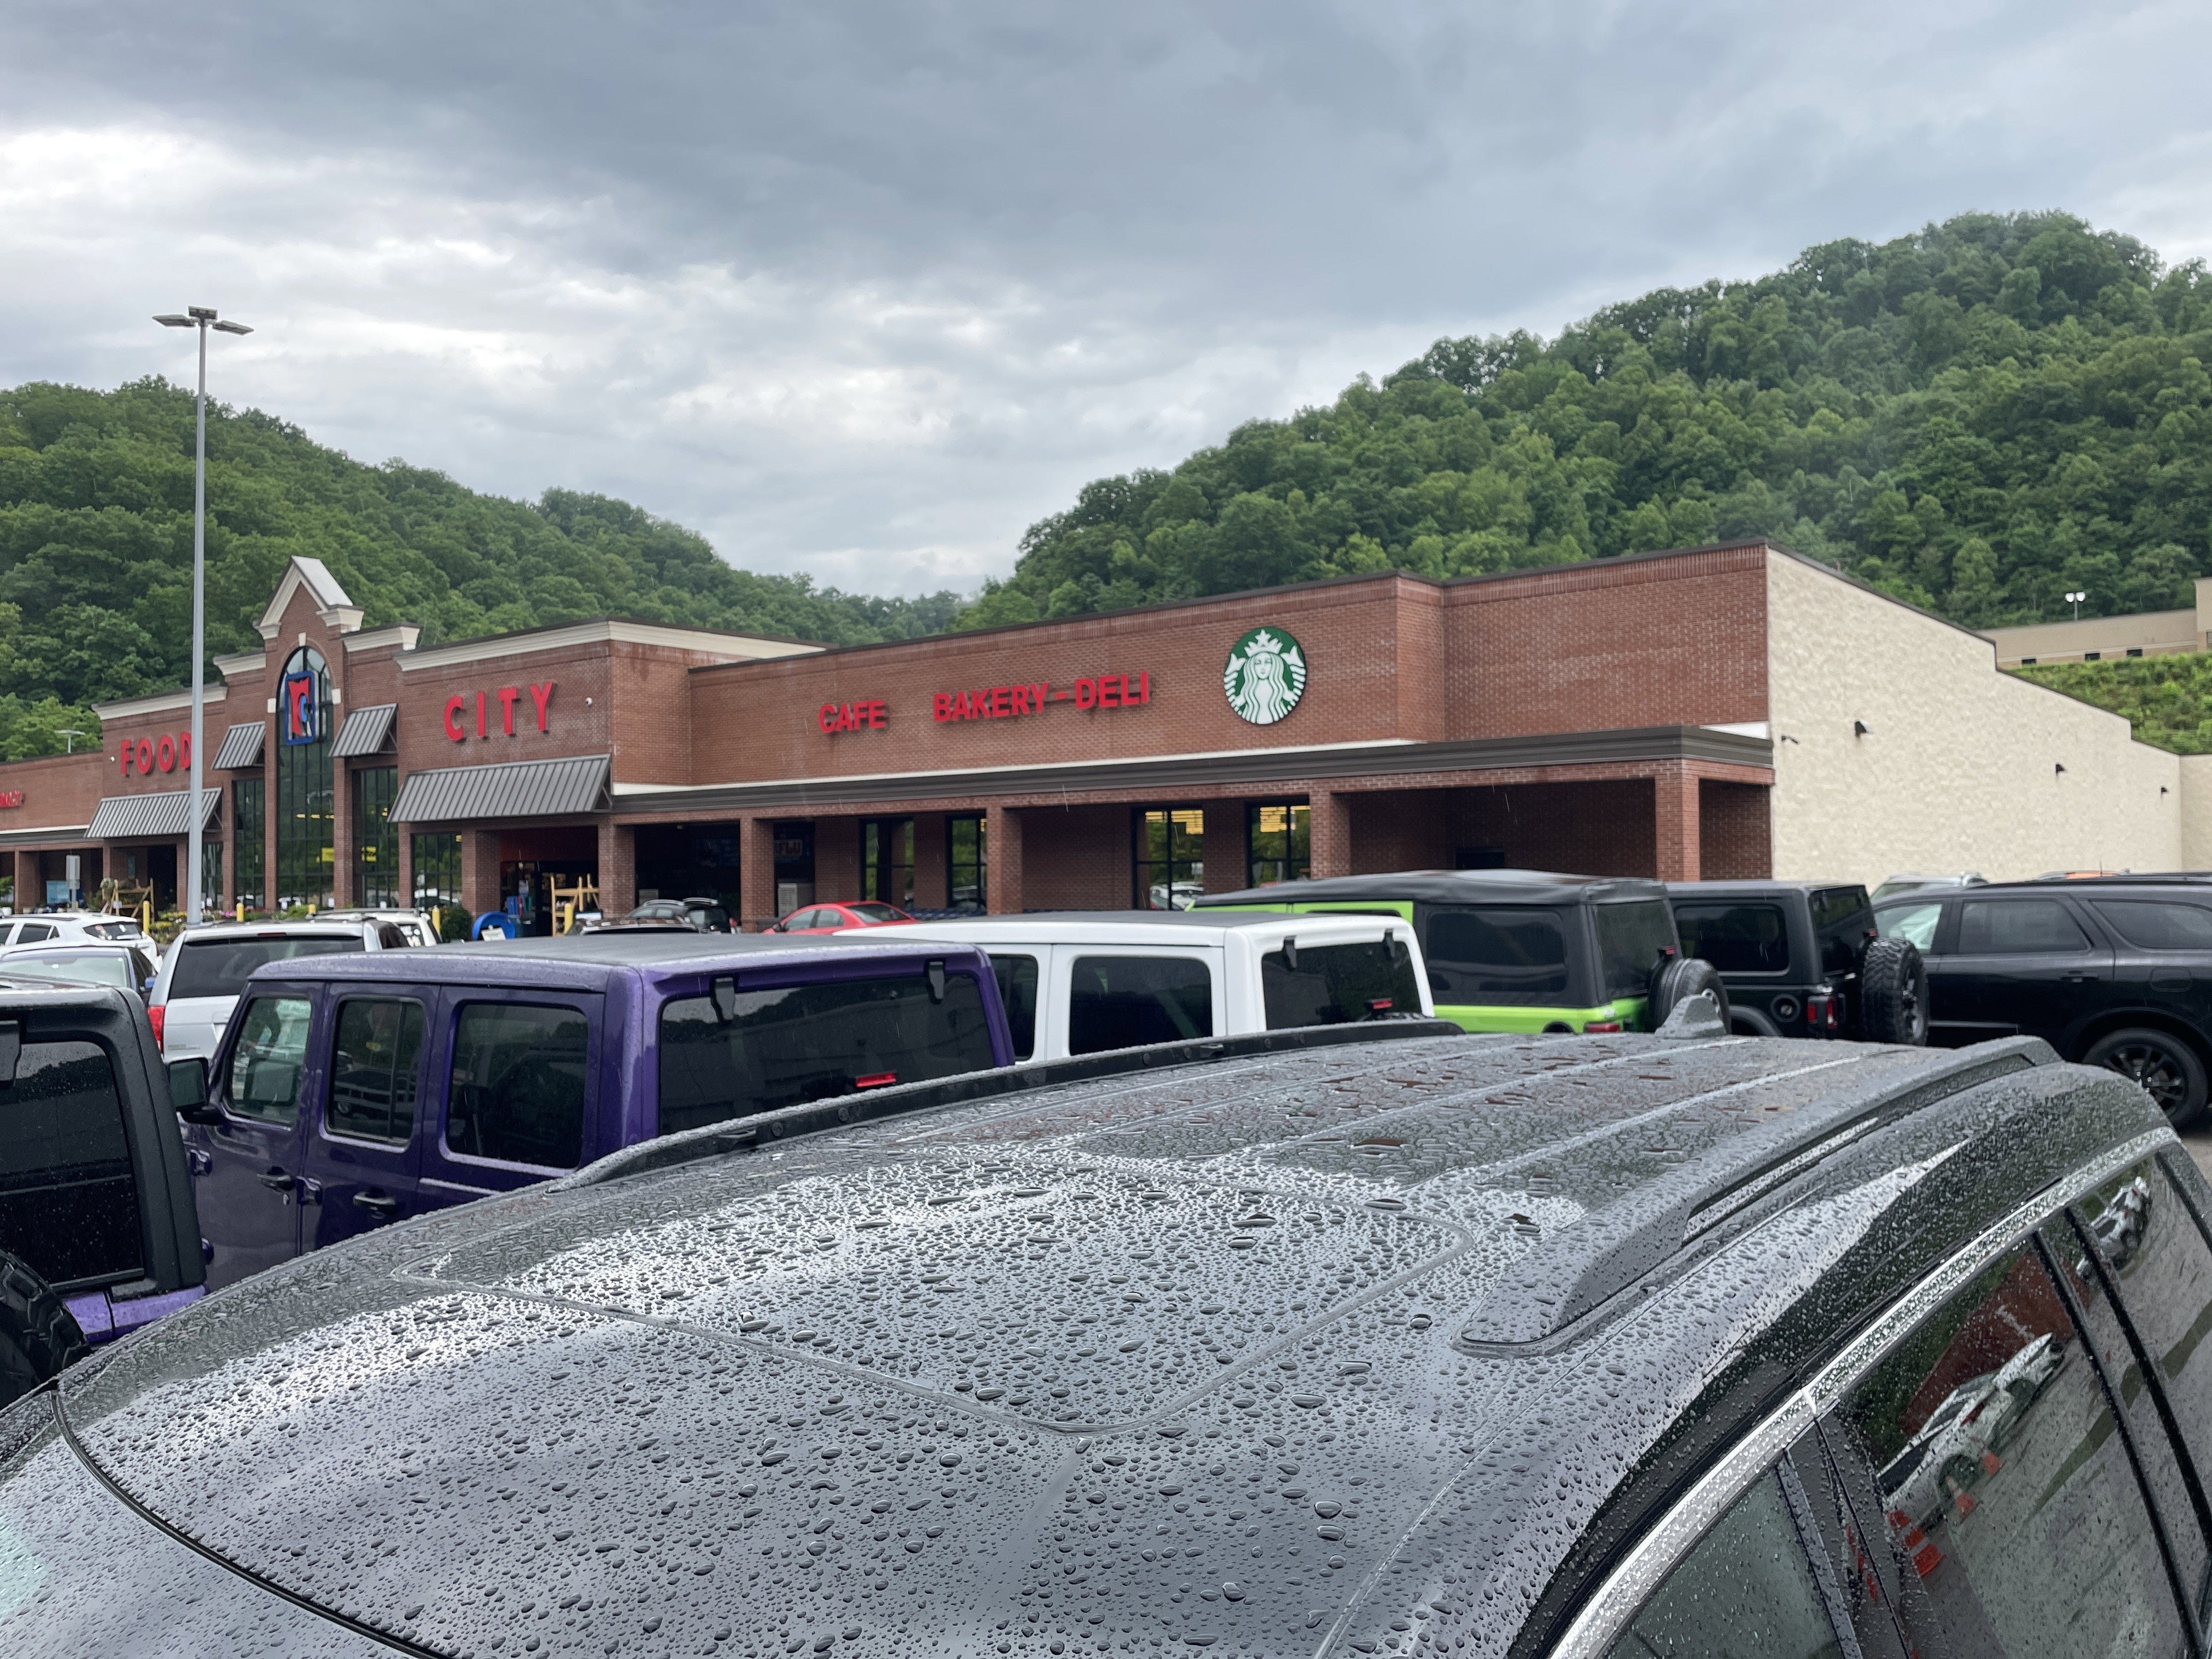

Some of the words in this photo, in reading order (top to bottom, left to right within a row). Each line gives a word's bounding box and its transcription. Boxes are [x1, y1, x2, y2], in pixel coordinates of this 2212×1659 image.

[443, 682, 554, 742] CITY
[818, 699, 885, 733] CAFE
[933, 682, 1049, 723] BAKERY
[1074, 670, 1149, 709] DELI
[120, 731, 192, 775] FOOD
